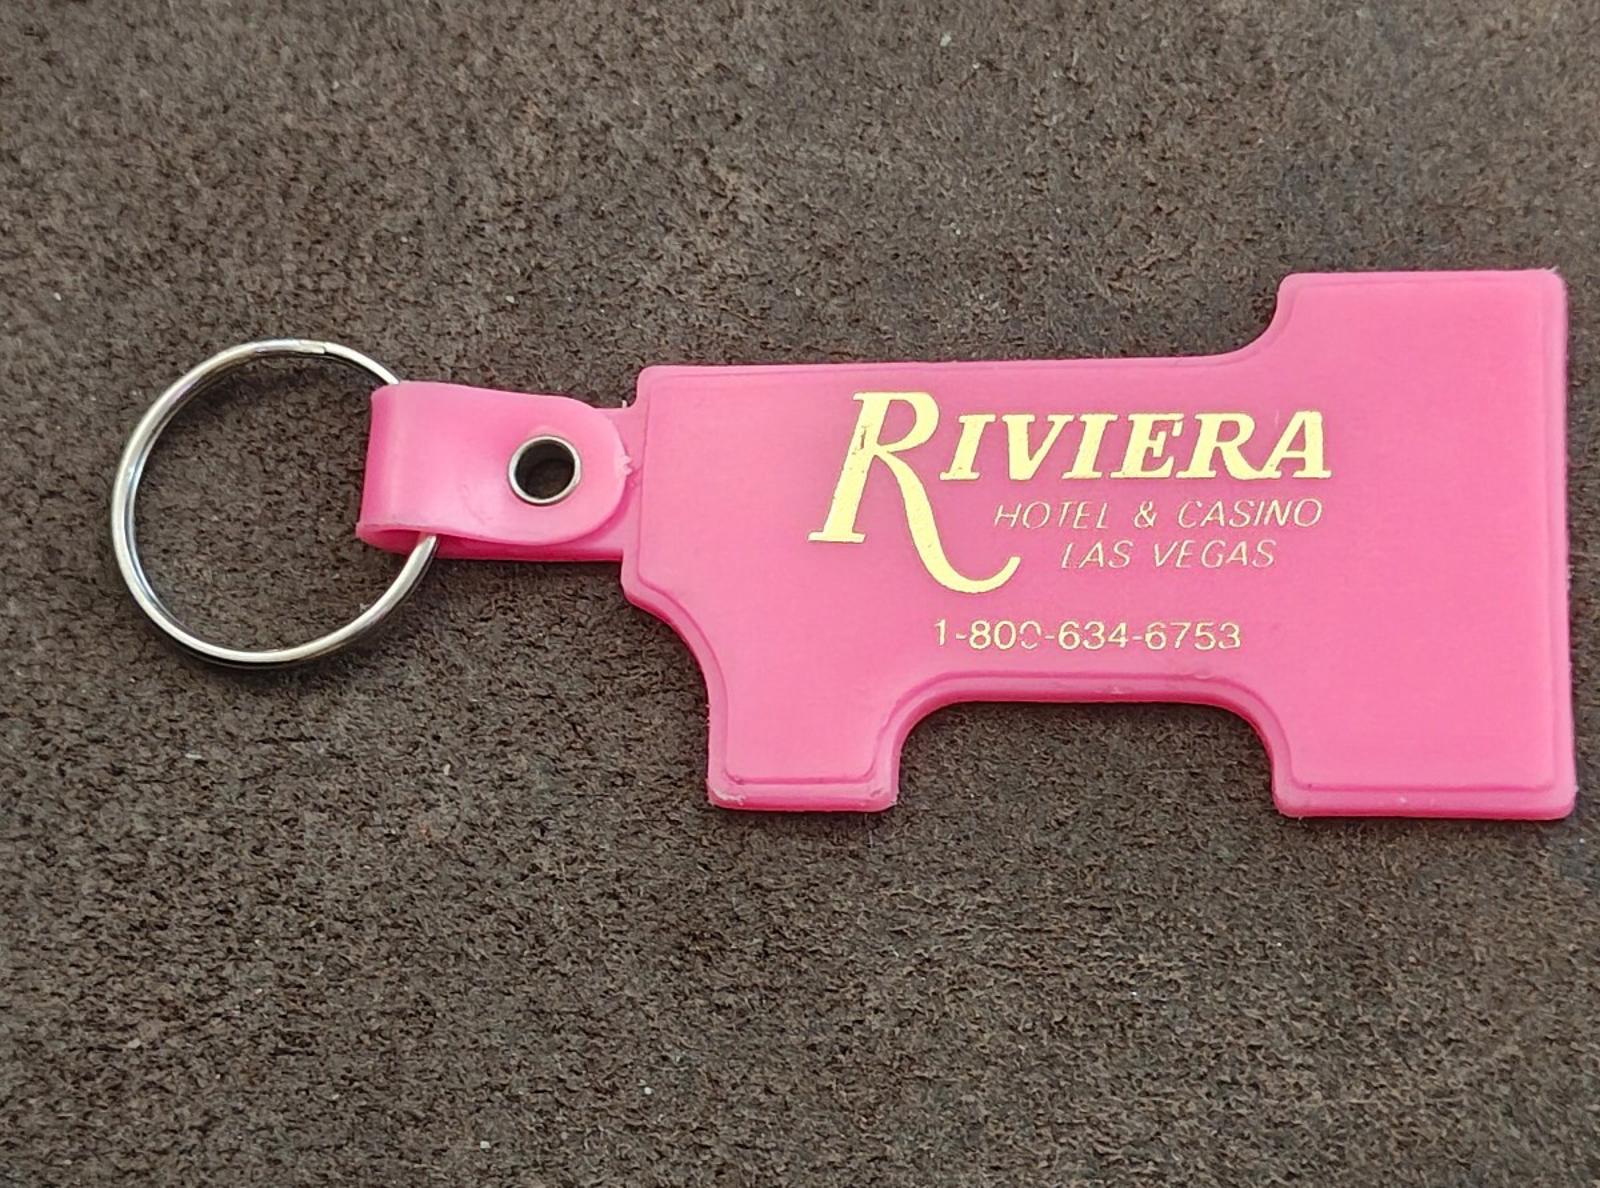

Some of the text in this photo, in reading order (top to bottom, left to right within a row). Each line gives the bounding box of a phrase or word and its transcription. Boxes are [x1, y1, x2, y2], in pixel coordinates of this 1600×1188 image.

[807, 391, 1333, 594] RIVIERA
[994, 497, 1323, 530] HOTEL & CASINO
[1061, 539, 1277, 569] LAS VEGAS
[934, 618, 1242, 651] 1-800-634-6753
